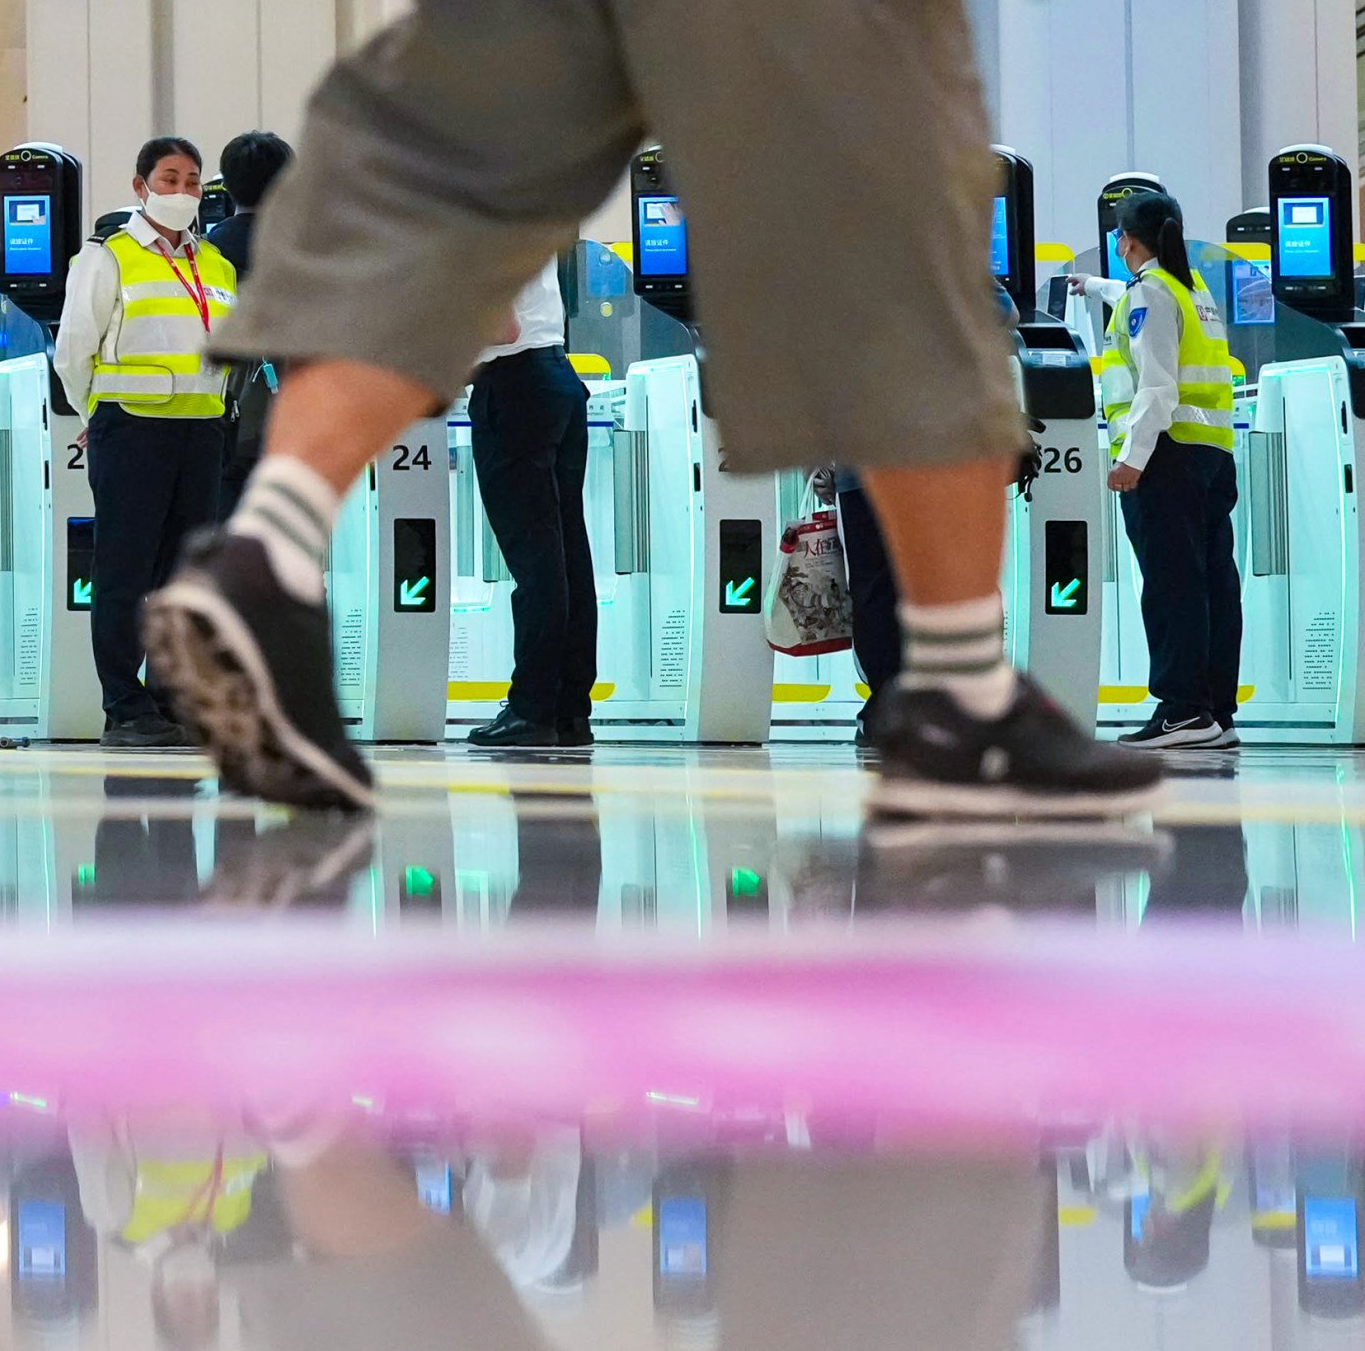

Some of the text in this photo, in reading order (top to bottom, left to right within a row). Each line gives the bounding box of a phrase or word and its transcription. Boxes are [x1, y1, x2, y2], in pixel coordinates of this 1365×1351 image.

[67, 444, 85, 470] 2
[393, 445, 432, 471] 24
[1043, 447, 1083, 473] 26
